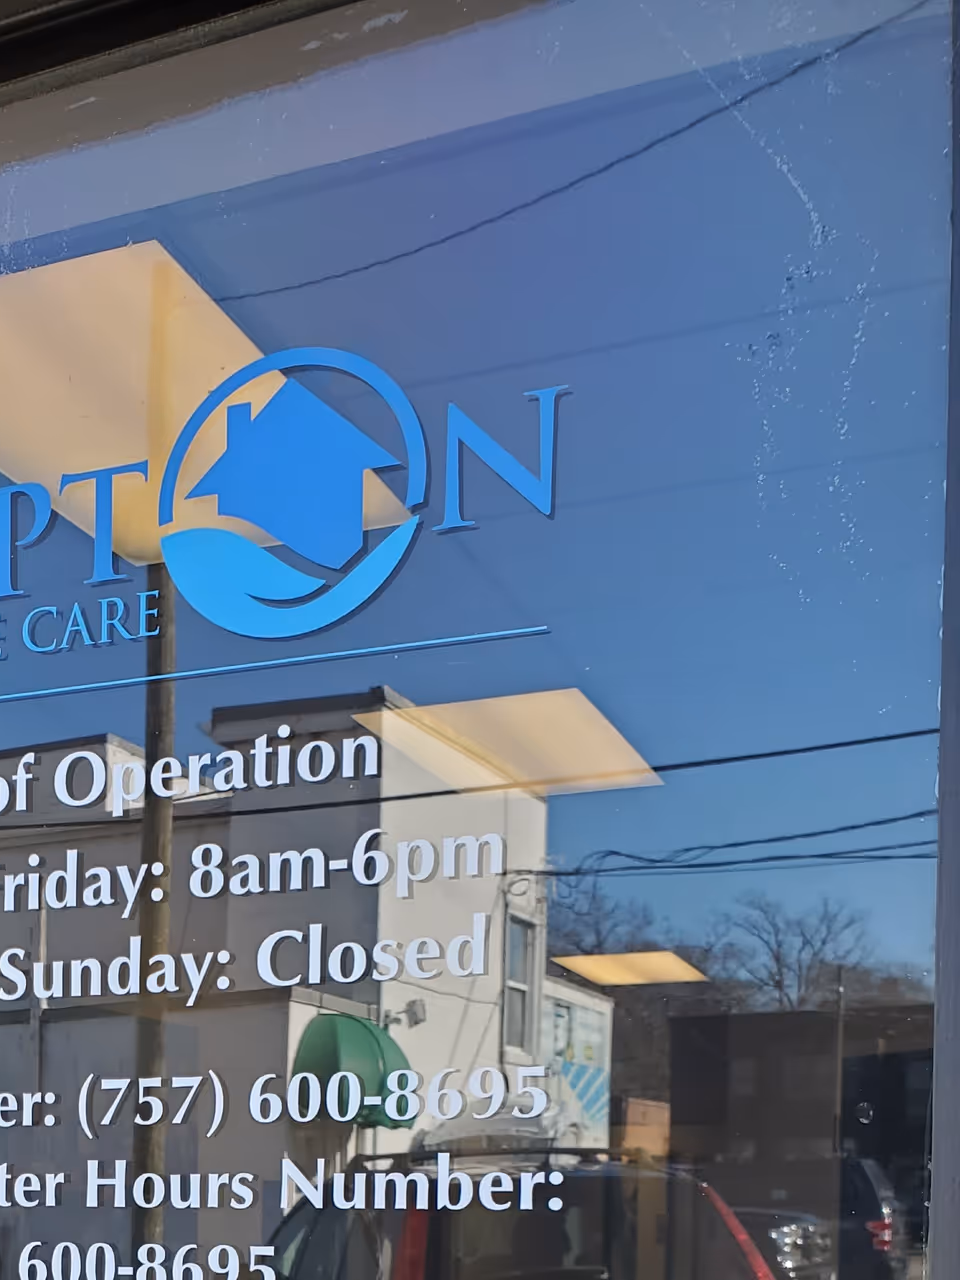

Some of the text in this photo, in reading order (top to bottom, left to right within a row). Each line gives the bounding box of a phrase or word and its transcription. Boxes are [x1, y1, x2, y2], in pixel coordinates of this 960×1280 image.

[22, 590, 160, 654] CARE
[53, 724, 381, 818] Operation
[188, 829, 506, 898] 8am-6pm
[255, 913, 490, 987] Closed
[77, 1070, 225, 1140] (757)
[248, 1064, 549, 1126] 600-8695
[86, 1160, 254, 1212] Hours
[279, 1152, 564, 1212] Number:
